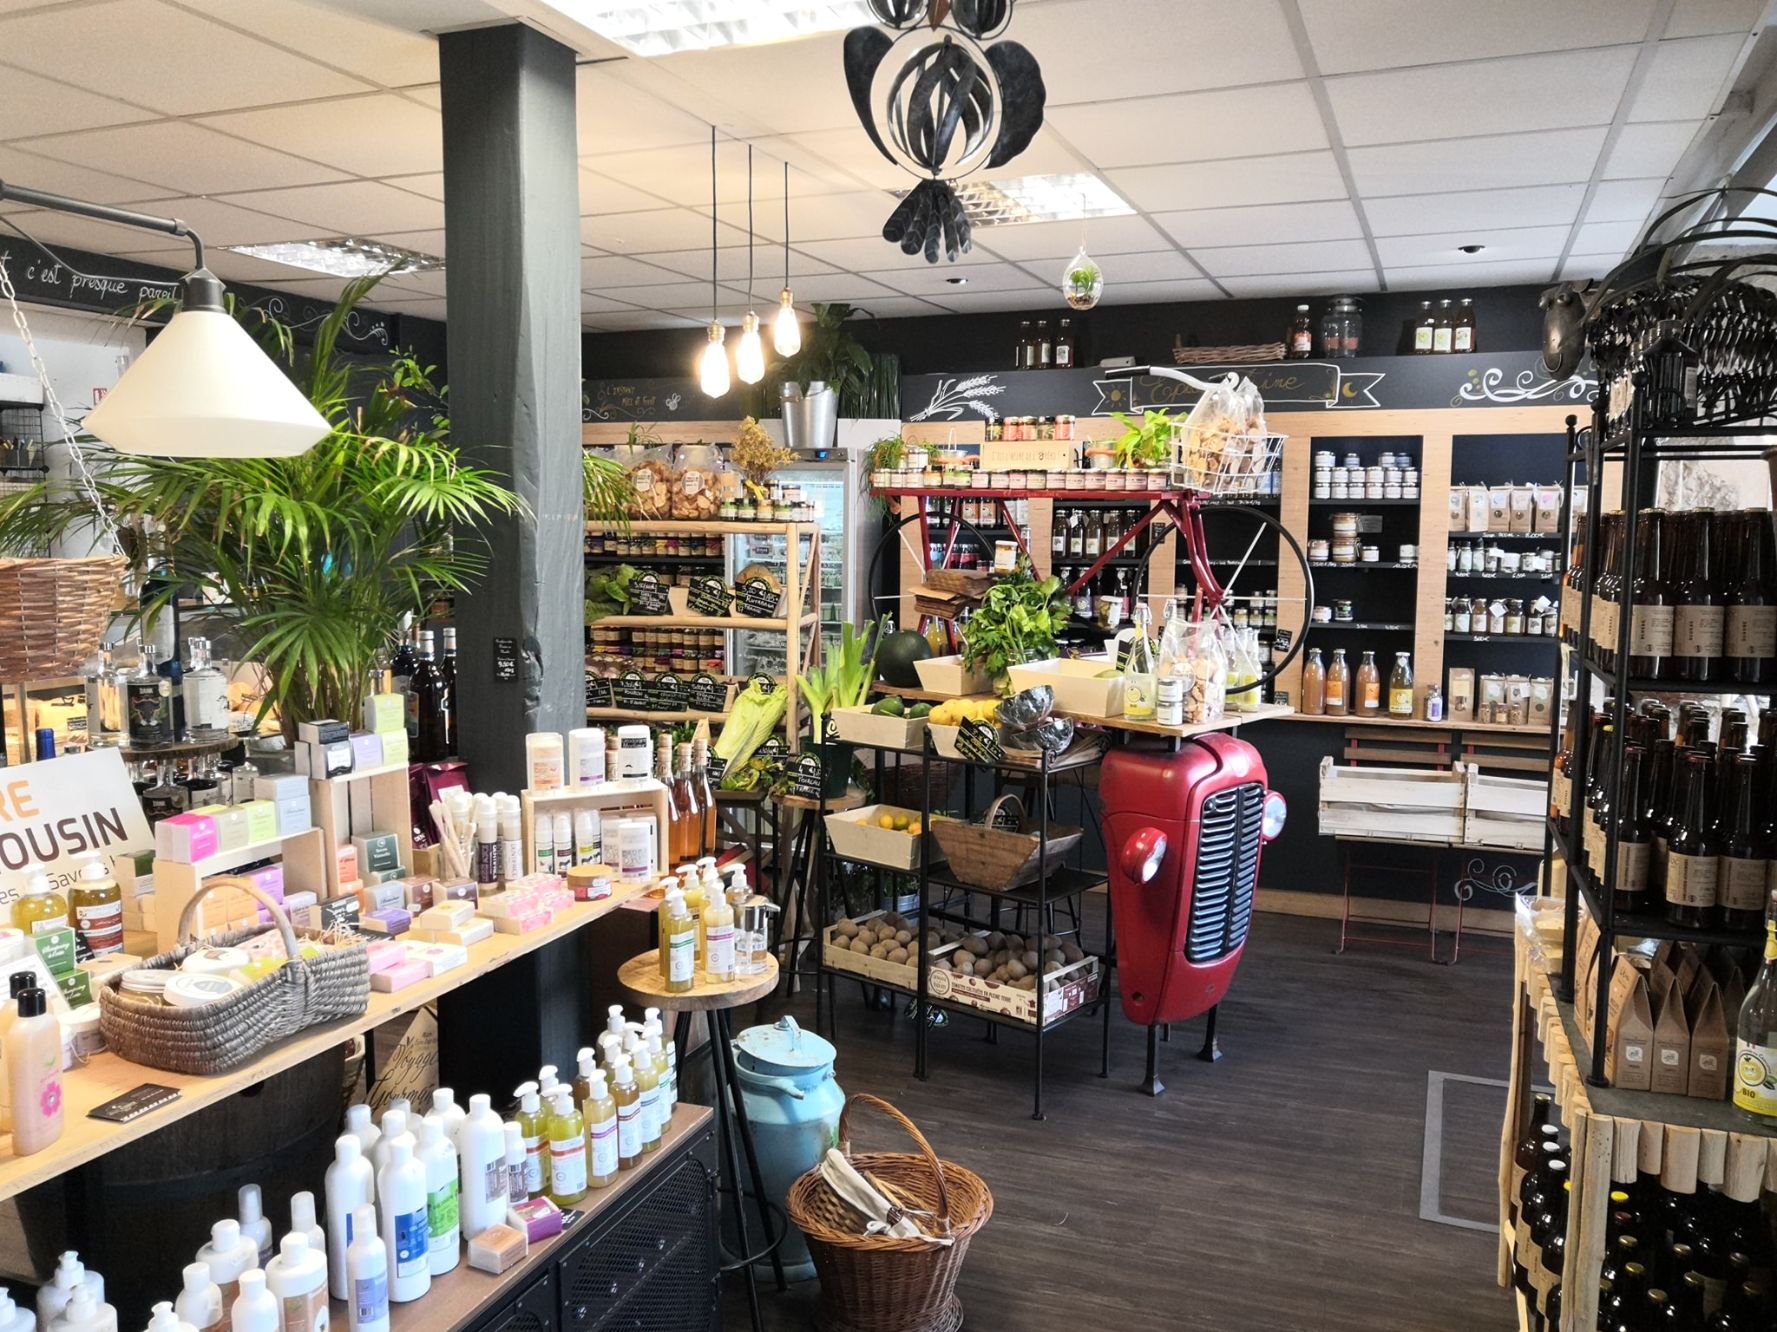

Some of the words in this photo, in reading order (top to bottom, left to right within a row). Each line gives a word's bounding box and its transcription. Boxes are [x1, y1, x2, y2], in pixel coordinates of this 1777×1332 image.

[26, 258, 62, 285] c'est
[68, 273, 128, 299] presque
[1742, 1088, 1756, 1098] BIO
